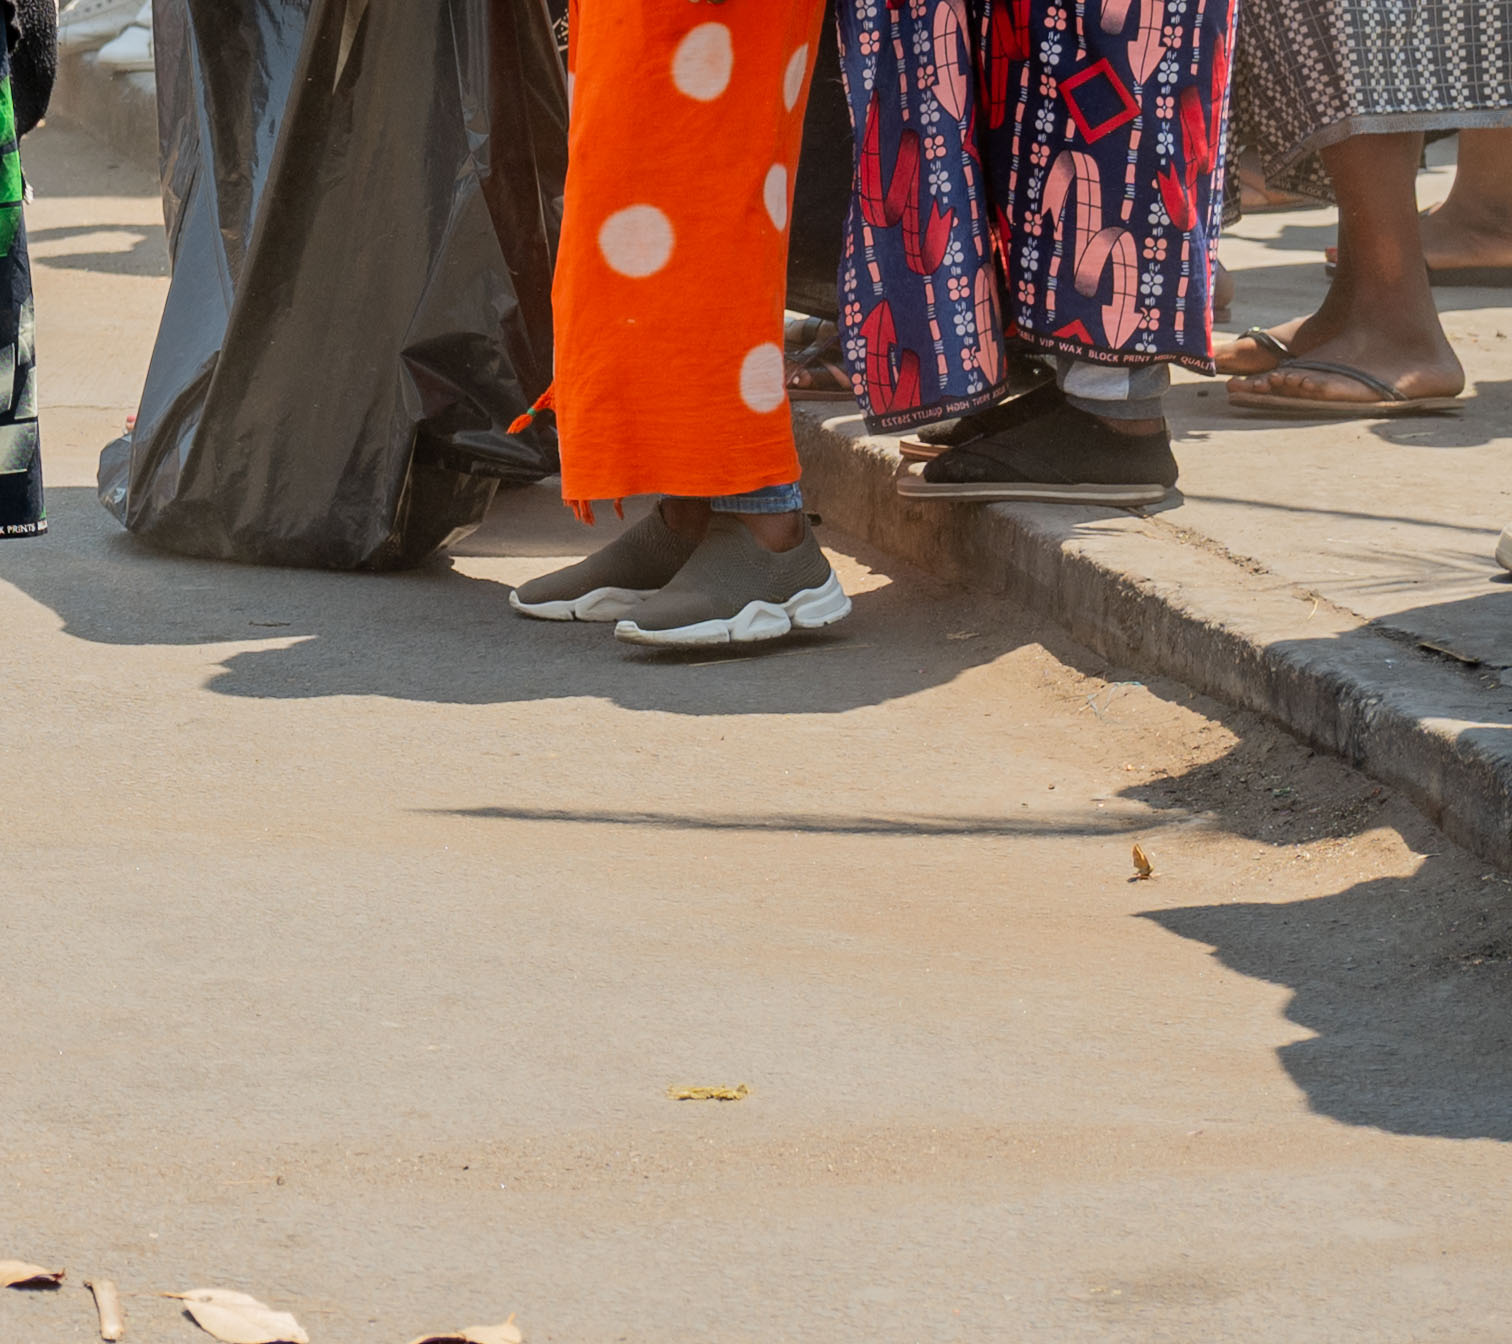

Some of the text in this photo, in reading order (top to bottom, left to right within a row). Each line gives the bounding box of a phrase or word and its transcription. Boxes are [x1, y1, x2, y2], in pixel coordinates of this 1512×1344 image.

[1039, 337, 1054, 348] VIP
[1058, 342, 1083, 356] WAX
[1088, 349, 1119, 362] BLOCK
[1123, 354, 1150, 362] PRINT
[7, 523, 35, 534] PRINTS
